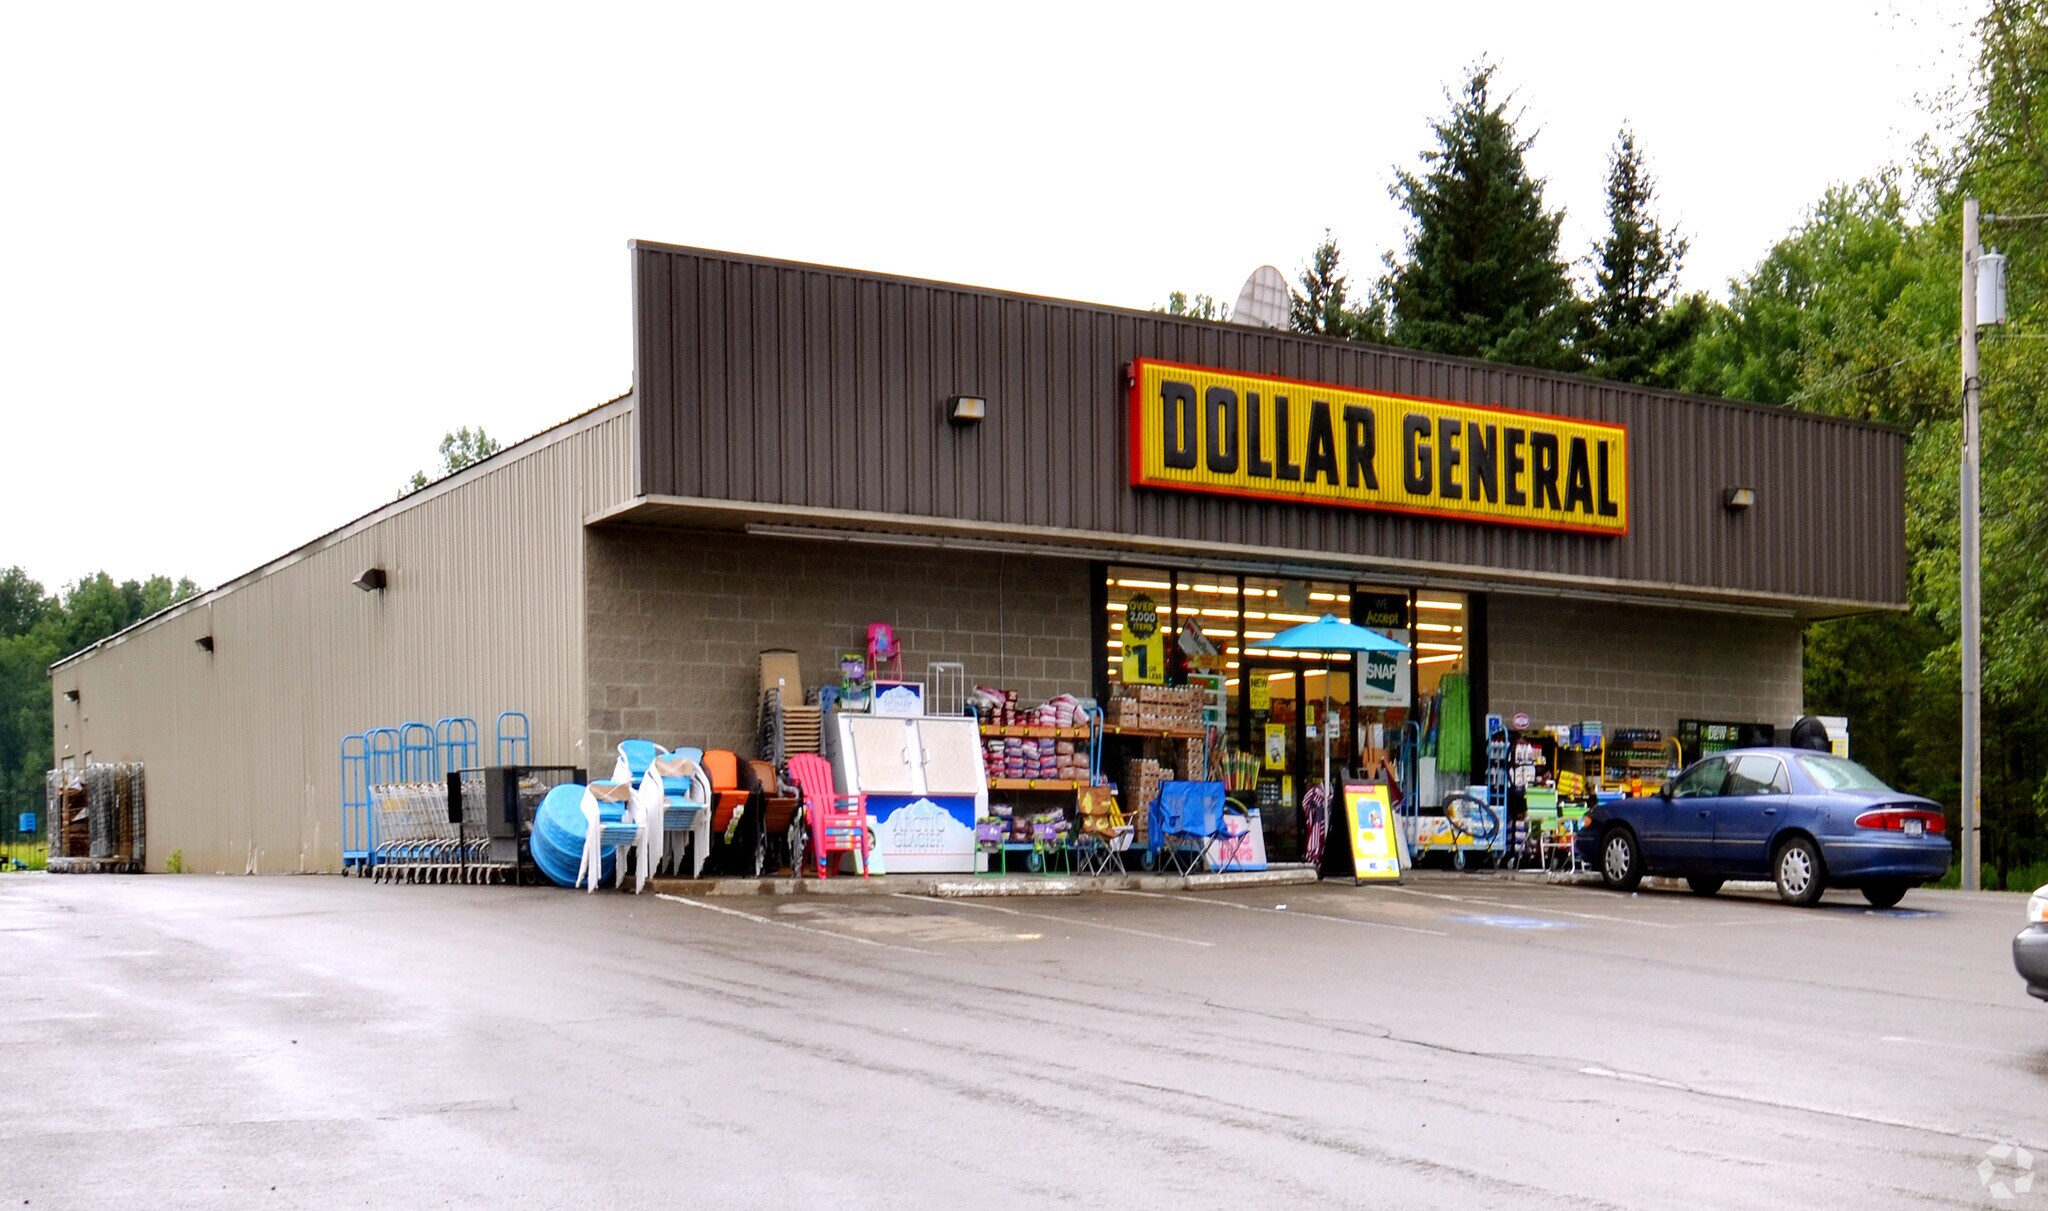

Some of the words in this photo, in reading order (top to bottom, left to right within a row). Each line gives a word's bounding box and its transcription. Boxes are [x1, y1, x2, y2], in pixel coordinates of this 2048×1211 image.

[1161, 379, 1379, 490] DOLLAR
[1403, 410, 1618, 517] GENERAL
[1129, 600, 1155, 612] OVER
[1375, 599, 1389, 610] WE
[1129, 610, 1156, 623] 2,000
[1366, 610, 1400, 626] Accept
[1366, 662, 1397, 680] SNAP
[1250, 678, 1269, 688] NEW
[1708, 725, 1727, 740] DEW
[893, 811, 947, 833] ARCTIC
[893, 831, 946, 849] GLACIER
